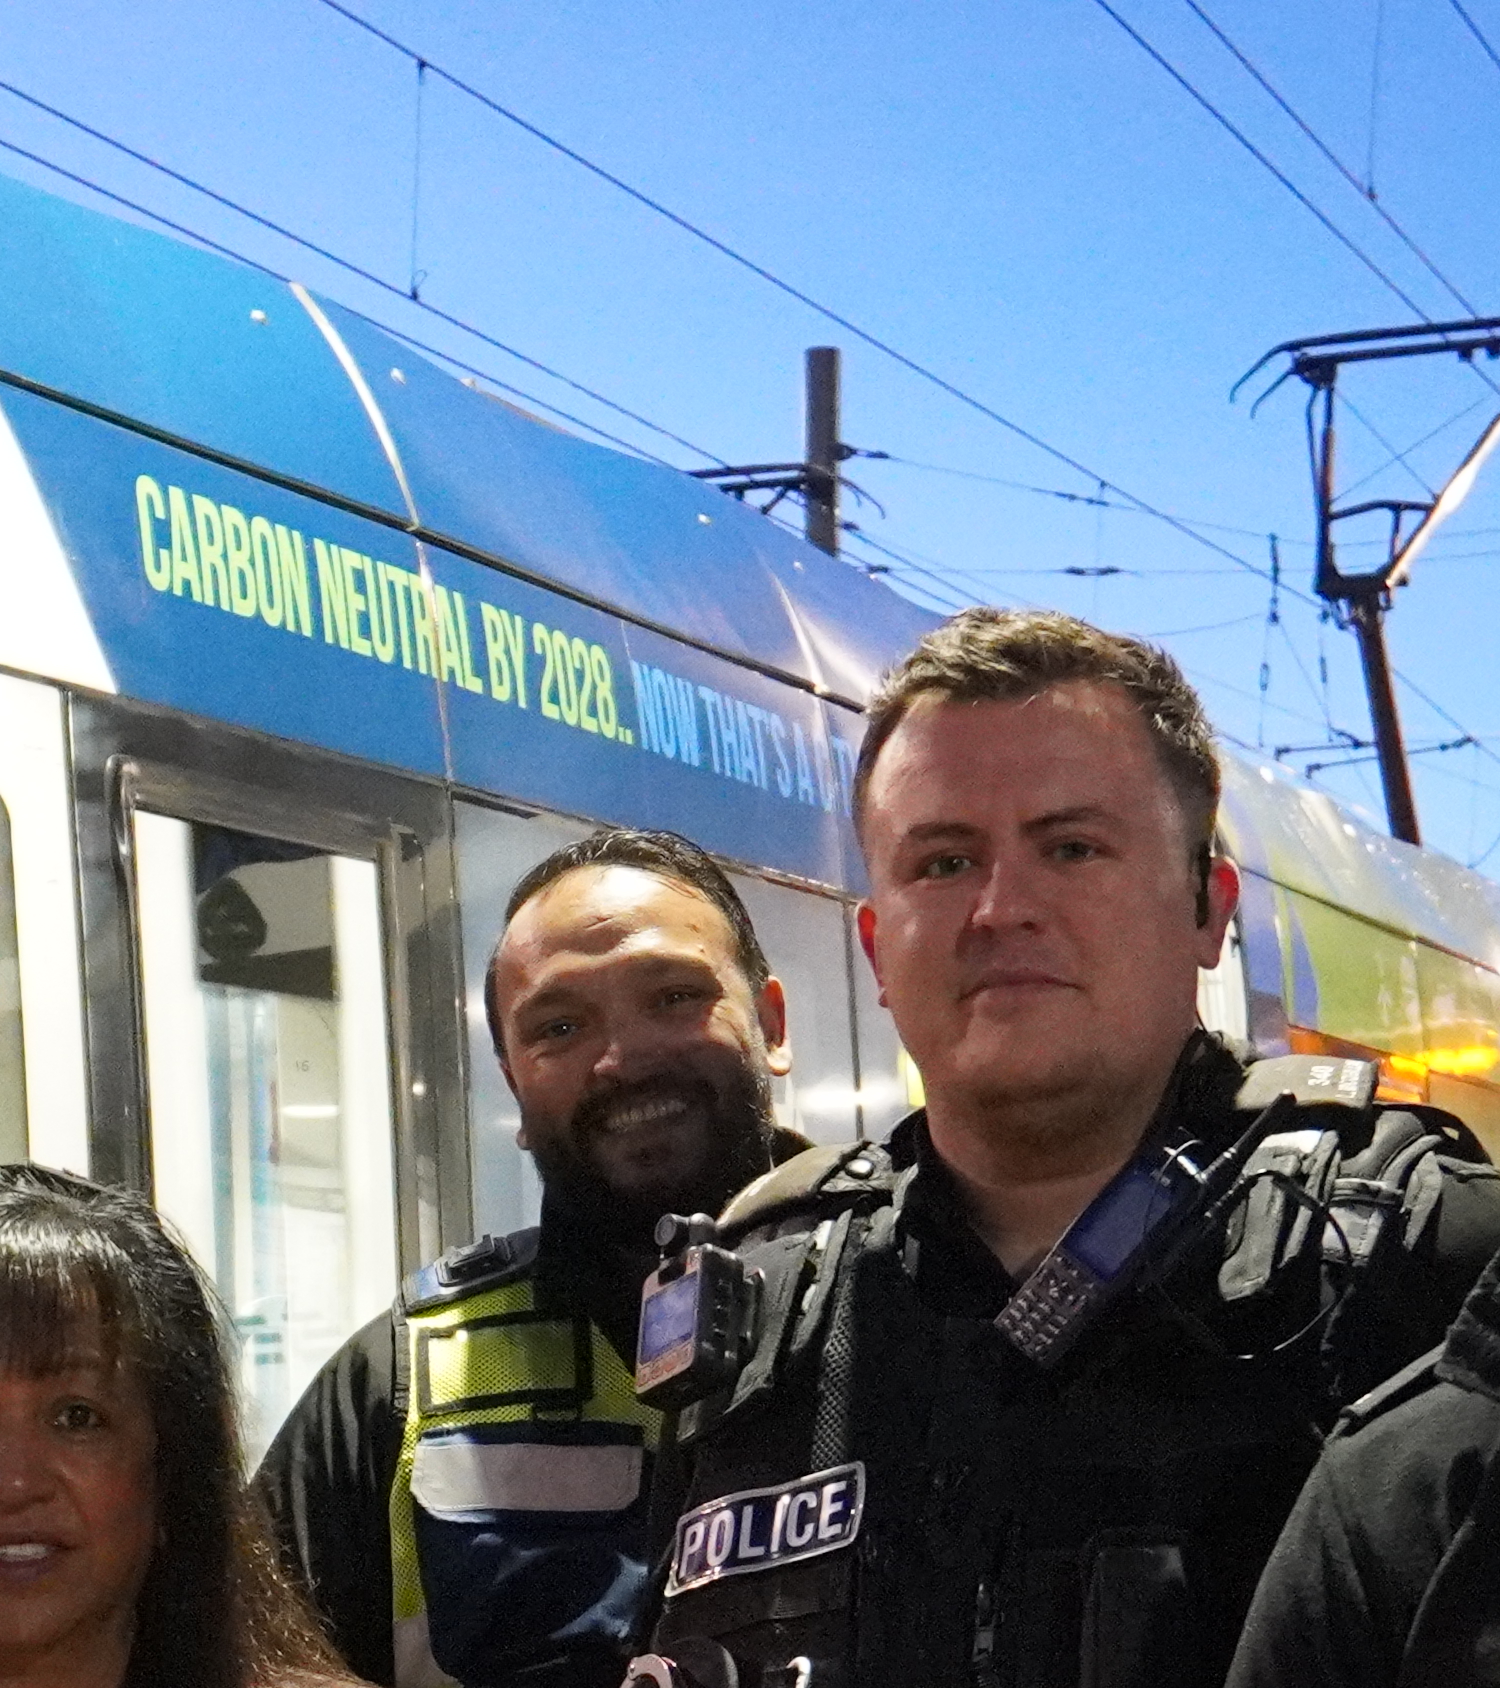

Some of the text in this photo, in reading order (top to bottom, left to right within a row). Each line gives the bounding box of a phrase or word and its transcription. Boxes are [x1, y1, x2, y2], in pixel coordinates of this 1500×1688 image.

[135, 474, 313, 638] CARBON
[313, 538, 484, 694] NEUTRAL
[480, 602, 527, 709] BY
[630, 659, 700, 767] NOW
[678, 1480, 848, 1579] POLICE
